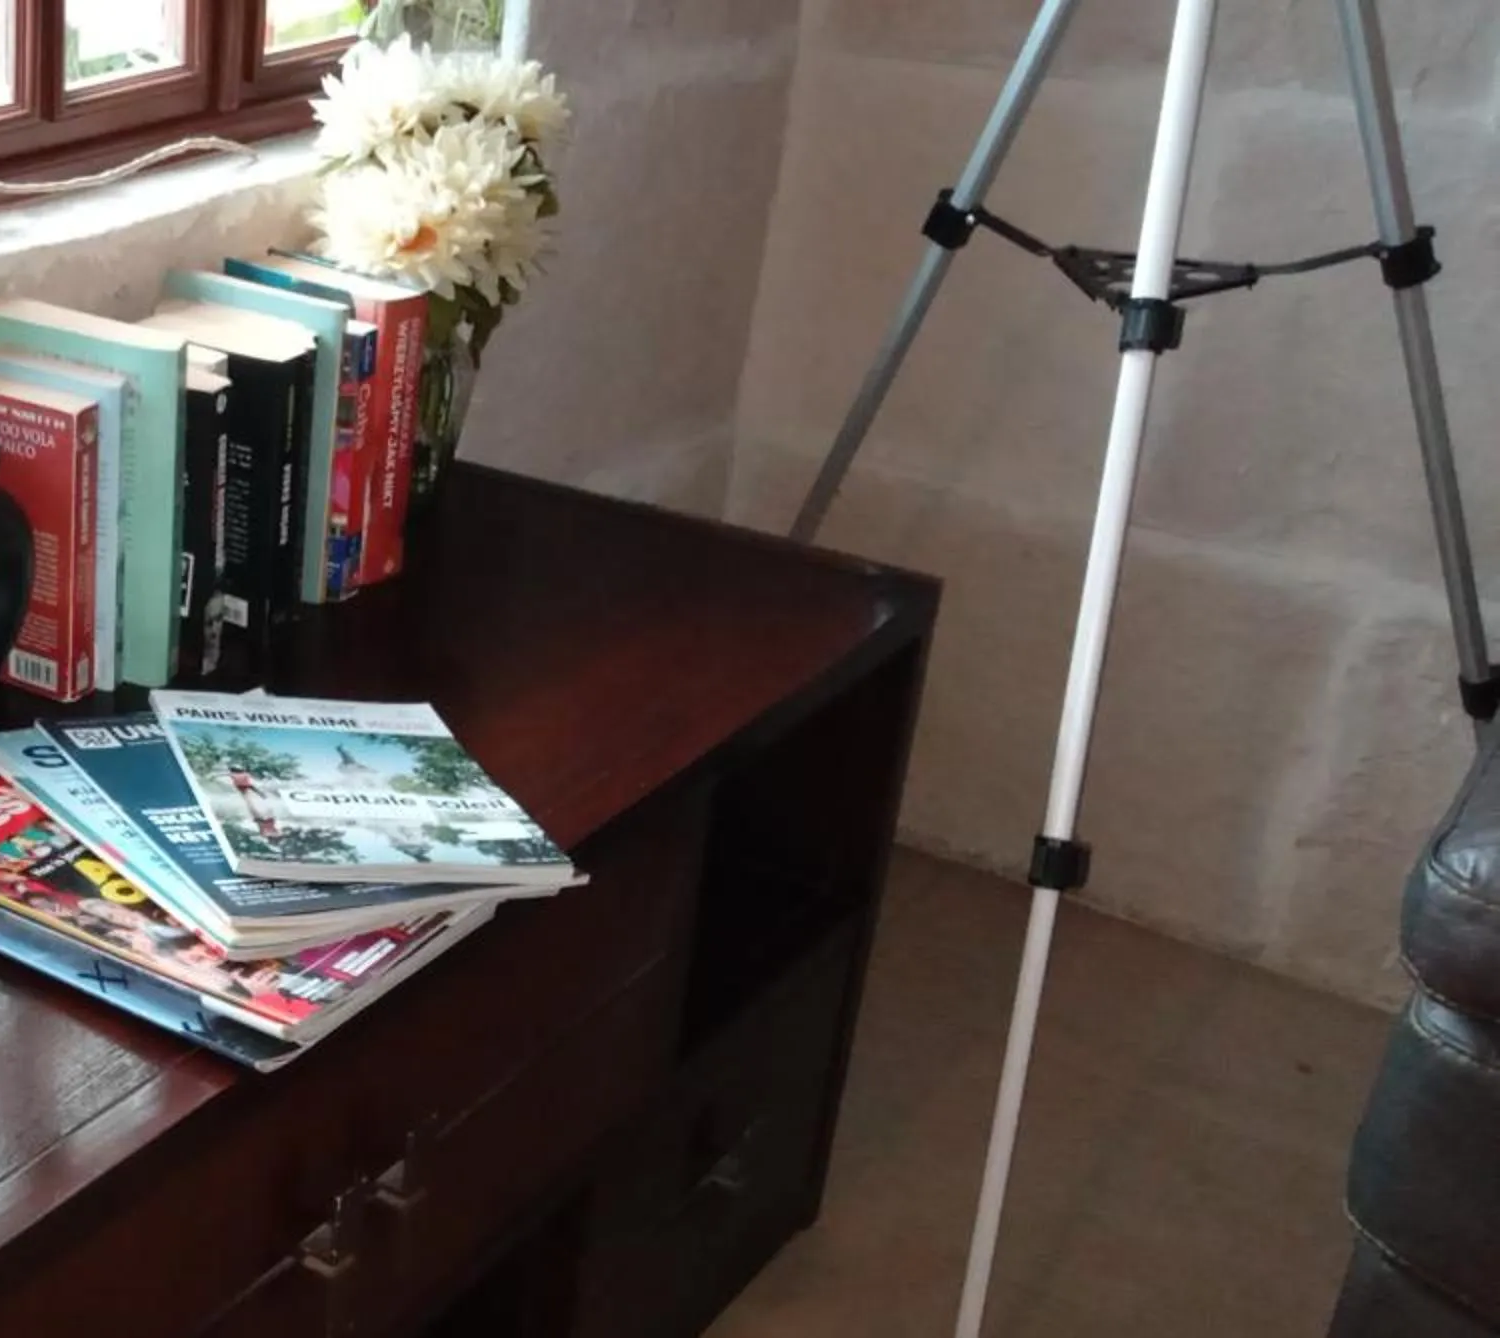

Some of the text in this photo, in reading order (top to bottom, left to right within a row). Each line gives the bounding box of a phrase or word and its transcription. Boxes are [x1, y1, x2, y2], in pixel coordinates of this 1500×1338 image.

[175, 706, 241, 723] PARIS
[243, 712, 301, 726] VOUS
[306, 715, 362, 729] AIME
[288, 790, 509, 811] Capitale soleil
